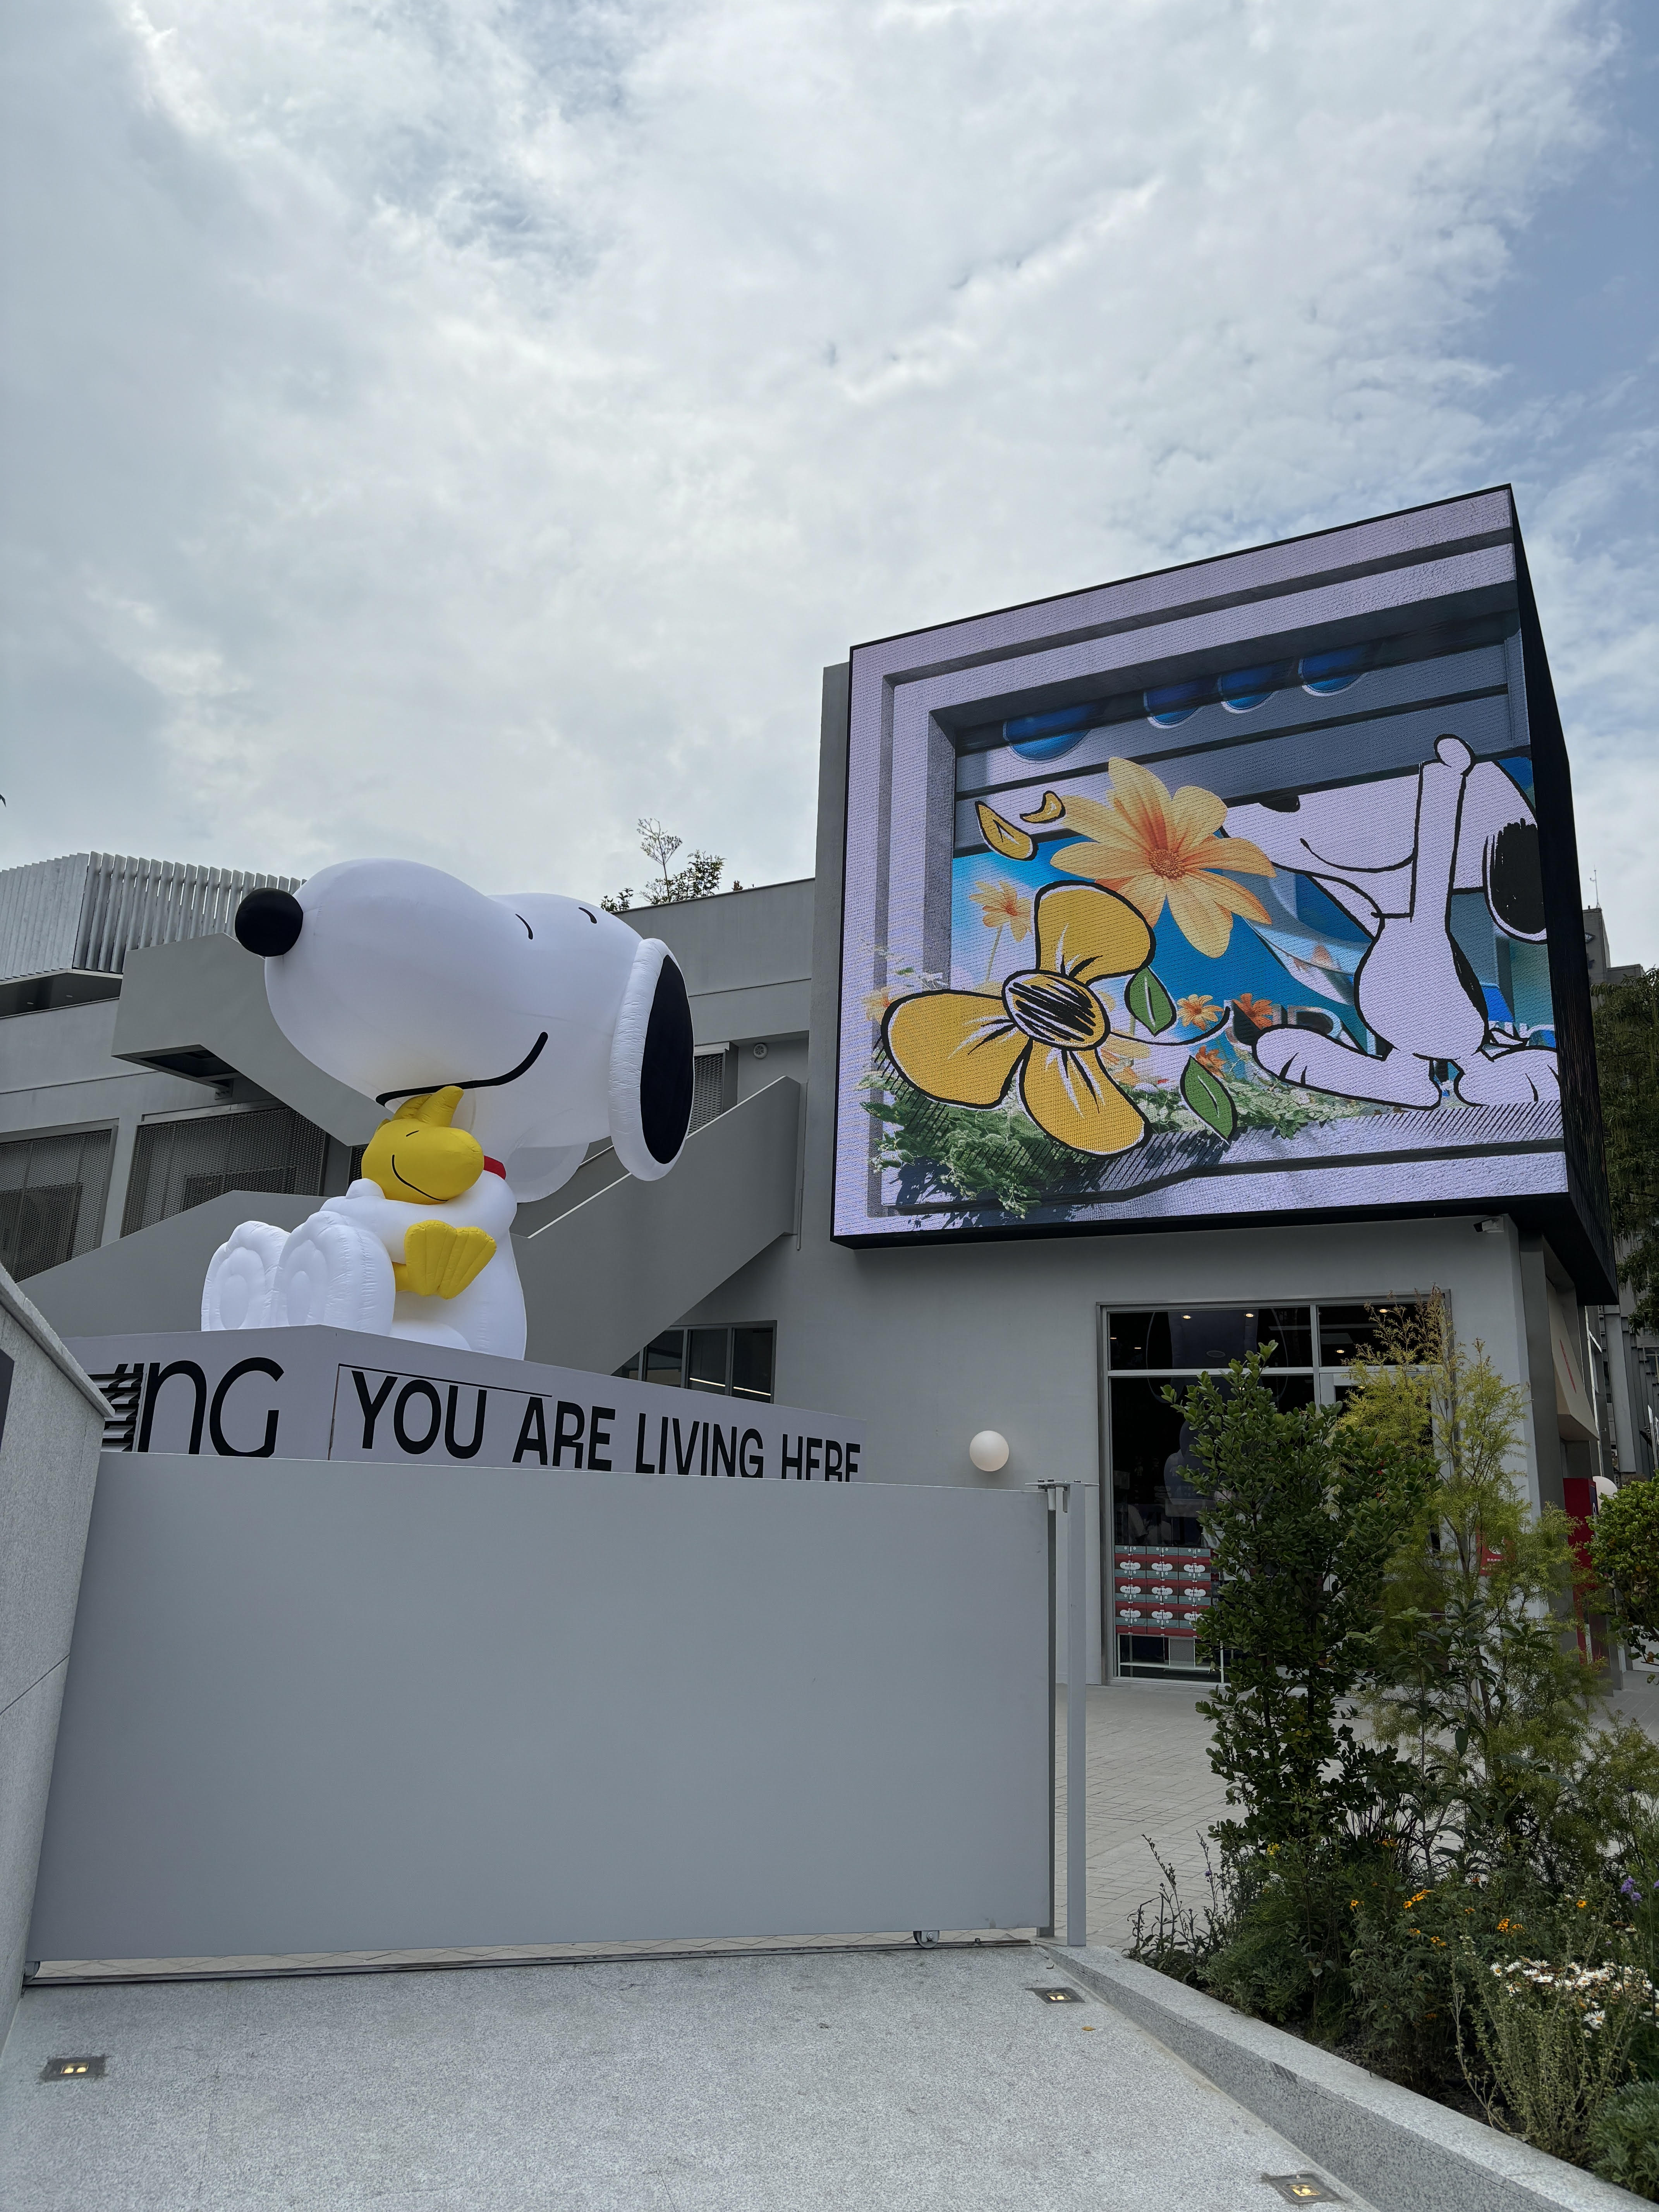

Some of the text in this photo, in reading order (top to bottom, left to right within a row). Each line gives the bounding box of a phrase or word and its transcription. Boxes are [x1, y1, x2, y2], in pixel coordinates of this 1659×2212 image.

[351, 1370, 487, 1459] YOU
[512, 1396, 616, 1472] ARE
[635, 1413, 764, 1479] LIVING
